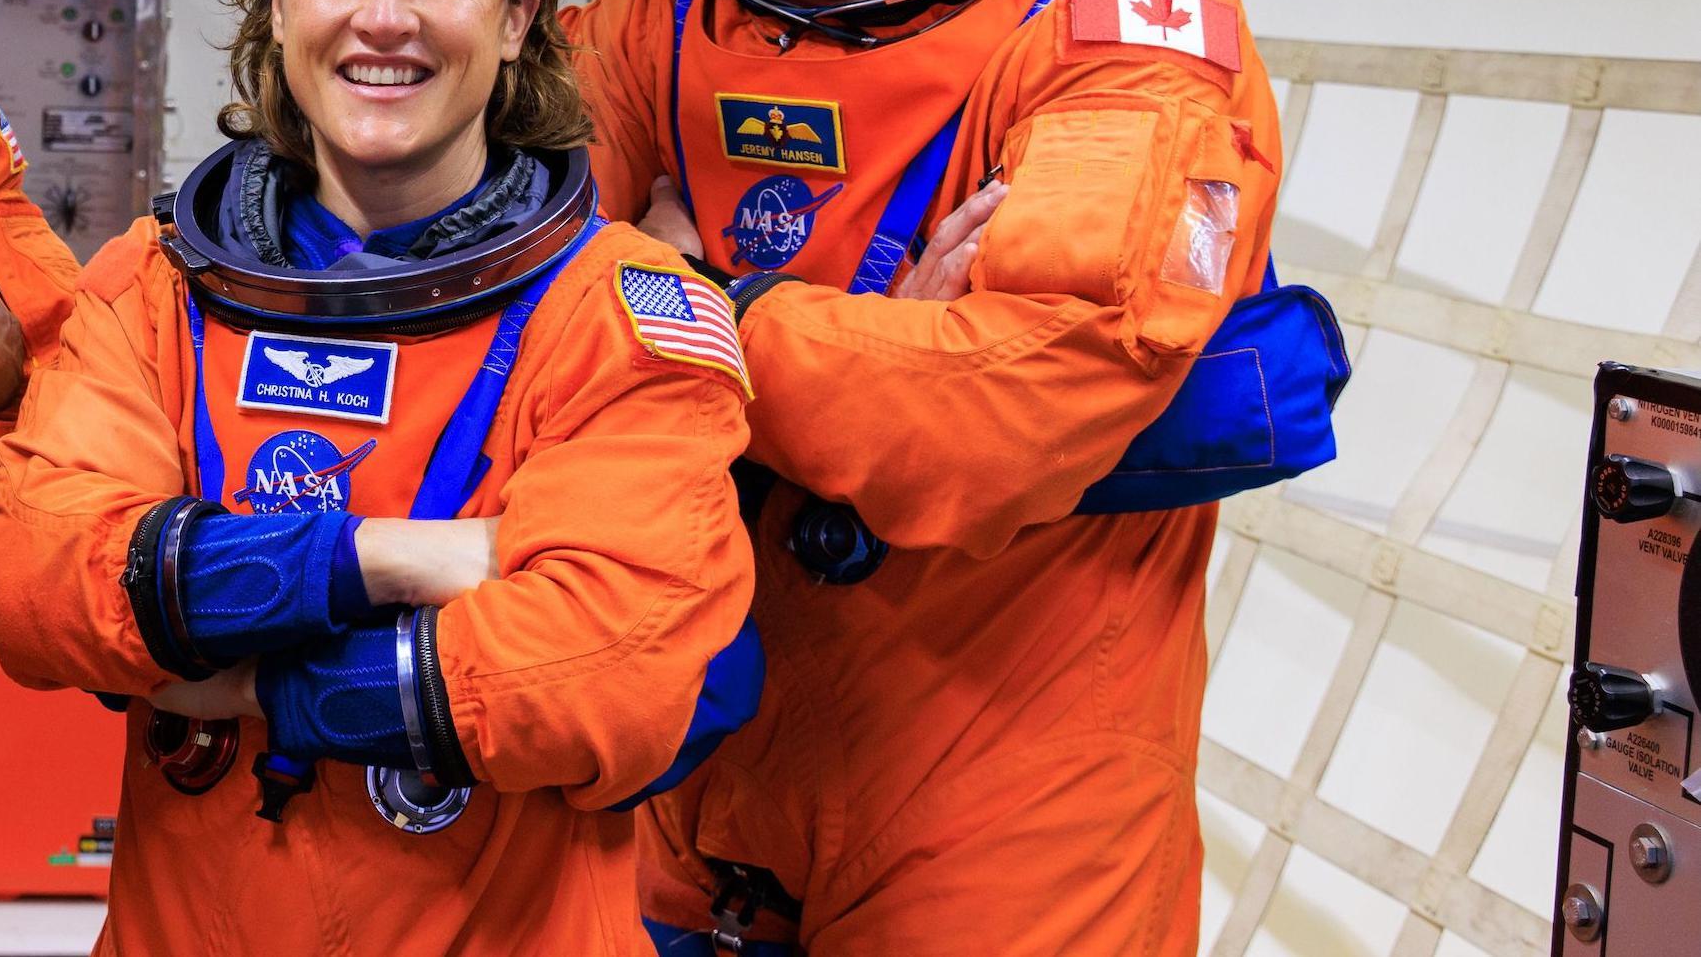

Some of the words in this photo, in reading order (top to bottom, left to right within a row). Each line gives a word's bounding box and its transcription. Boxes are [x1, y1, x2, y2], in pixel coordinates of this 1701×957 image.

[740, 143, 775, 158] JEREMY
[781, 148, 824, 165] HANSEN
[739, 207, 807, 237] NASA
[256, 383, 313, 401] CHRISTINA
[319, 390, 330, 403] H.
[336, 392, 369, 408] KOCH
[1637, 399, 1680, 419] NITROGEN
[254, 468, 343, 501] NASA
[1638, 539, 1660, 556] VENT
[1662, 546, 1689, 565] VALVE
[1605, 737, 1635, 758] GAUGE
[1636, 748, 1680, 778] ISOLATION
[1627, 759, 1654, 782] VALVE
